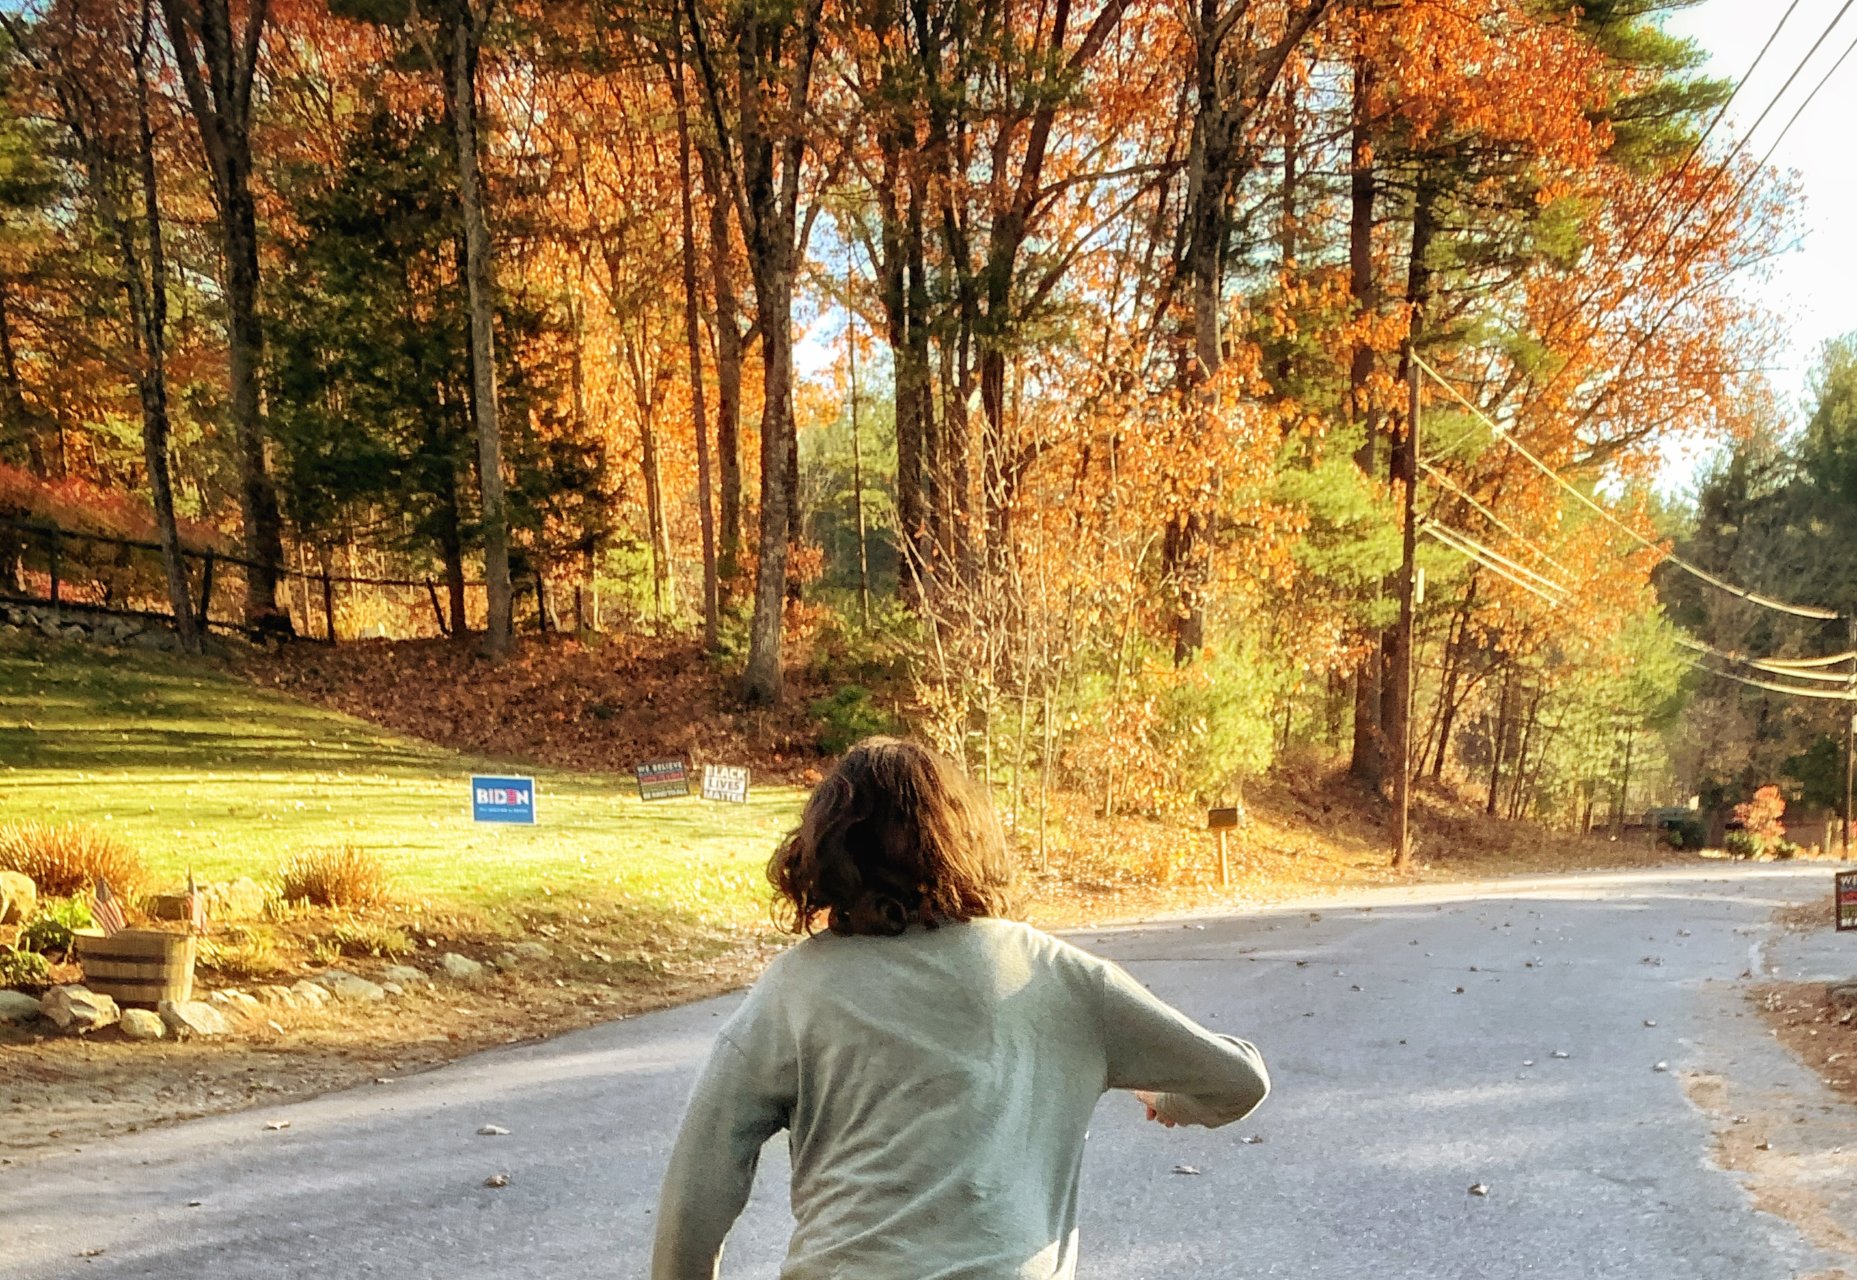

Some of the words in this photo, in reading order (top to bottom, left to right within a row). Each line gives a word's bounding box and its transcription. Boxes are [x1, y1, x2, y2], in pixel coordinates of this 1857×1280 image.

[705, 764, 746, 779] BLACK
[709, 779, 740, 790] LIVES
[476, 787, 530, 806] BIDEN
[704, 790, 744, 802] MATTER
